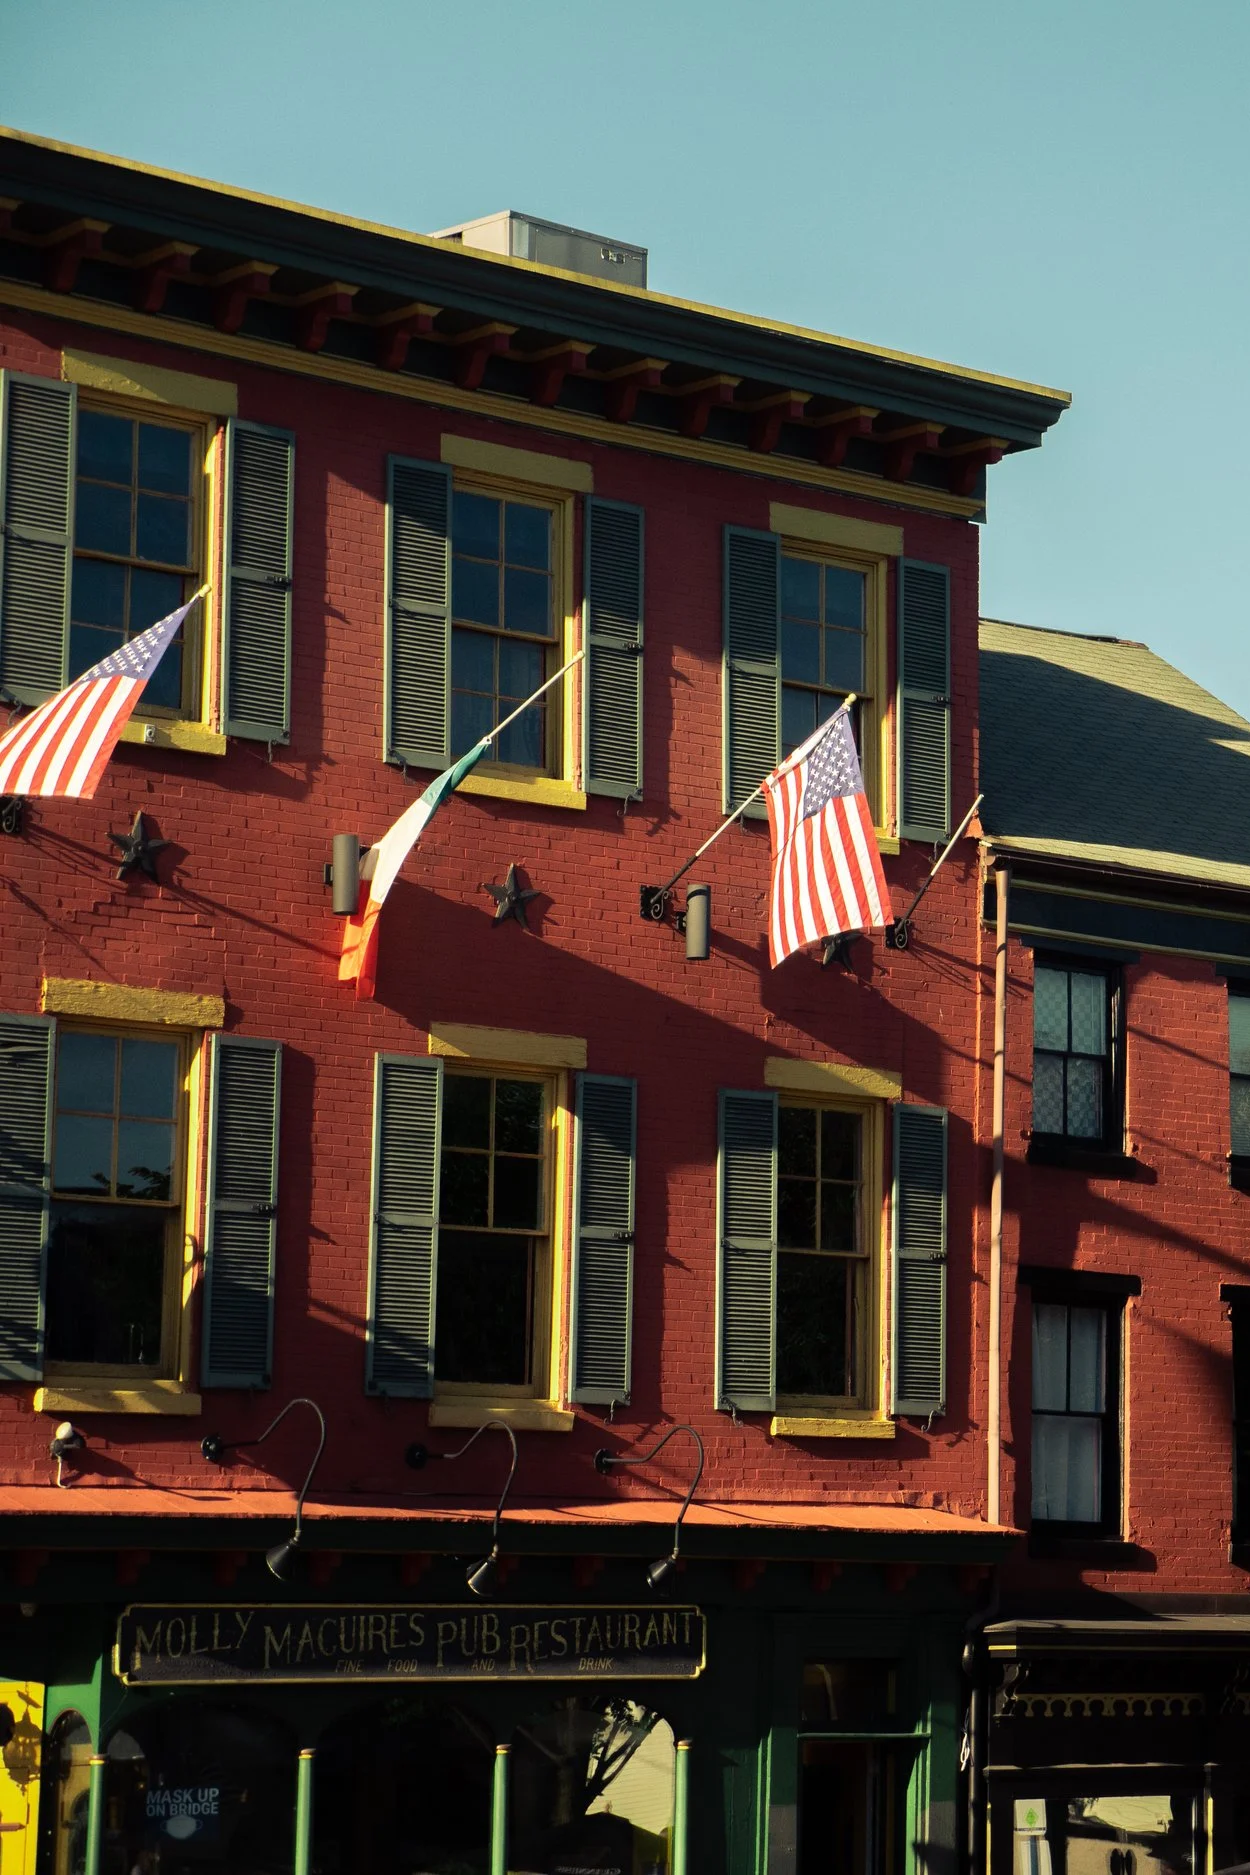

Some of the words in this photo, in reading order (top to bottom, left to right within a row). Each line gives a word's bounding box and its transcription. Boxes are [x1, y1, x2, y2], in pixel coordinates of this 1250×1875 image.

[133, 1611, 255, 1671] MOLLY
[436, 1613, 501, 1667] PUB
[509, 1611, 694, 1673] RESTAURANT
[335, 1659, 364, 1673] FINE
[387, 1658, 418, 1672] FOOD
[472, 1659, 495, 1672] AND
[579, 1658, 613, 1671] DRINK
[146, 1789, 193, 1804] MASK
[198, 1788, 219, 1802] UP
[146, 1804, 166, 1817] ON
[169, 1802, 219, 1816] BRIDGE
